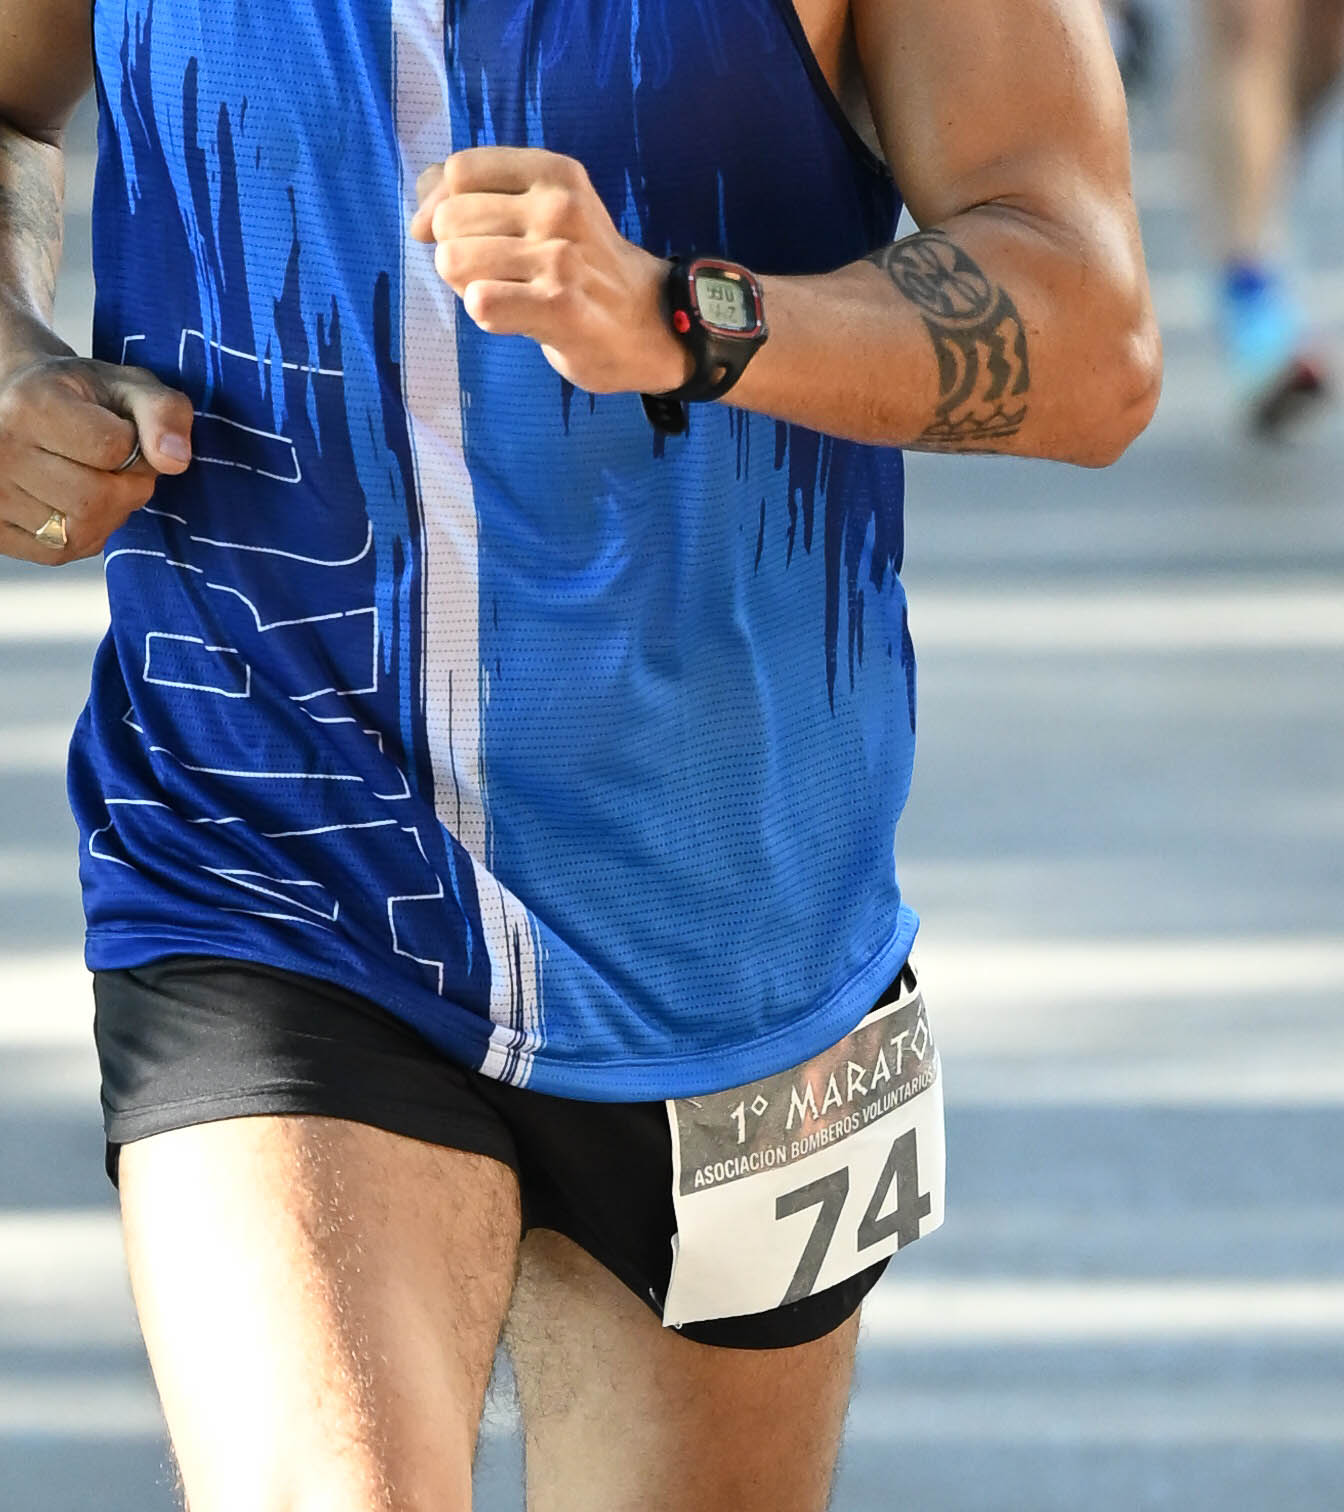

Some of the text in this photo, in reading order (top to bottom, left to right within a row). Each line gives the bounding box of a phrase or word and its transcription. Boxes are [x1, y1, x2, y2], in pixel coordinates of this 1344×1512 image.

[693, 1143, 787, 1188] ASOCIACIÓN
[791, 1111, 860, 1160] BOMBEROS
[774, 1126, 932, 1307] 74
